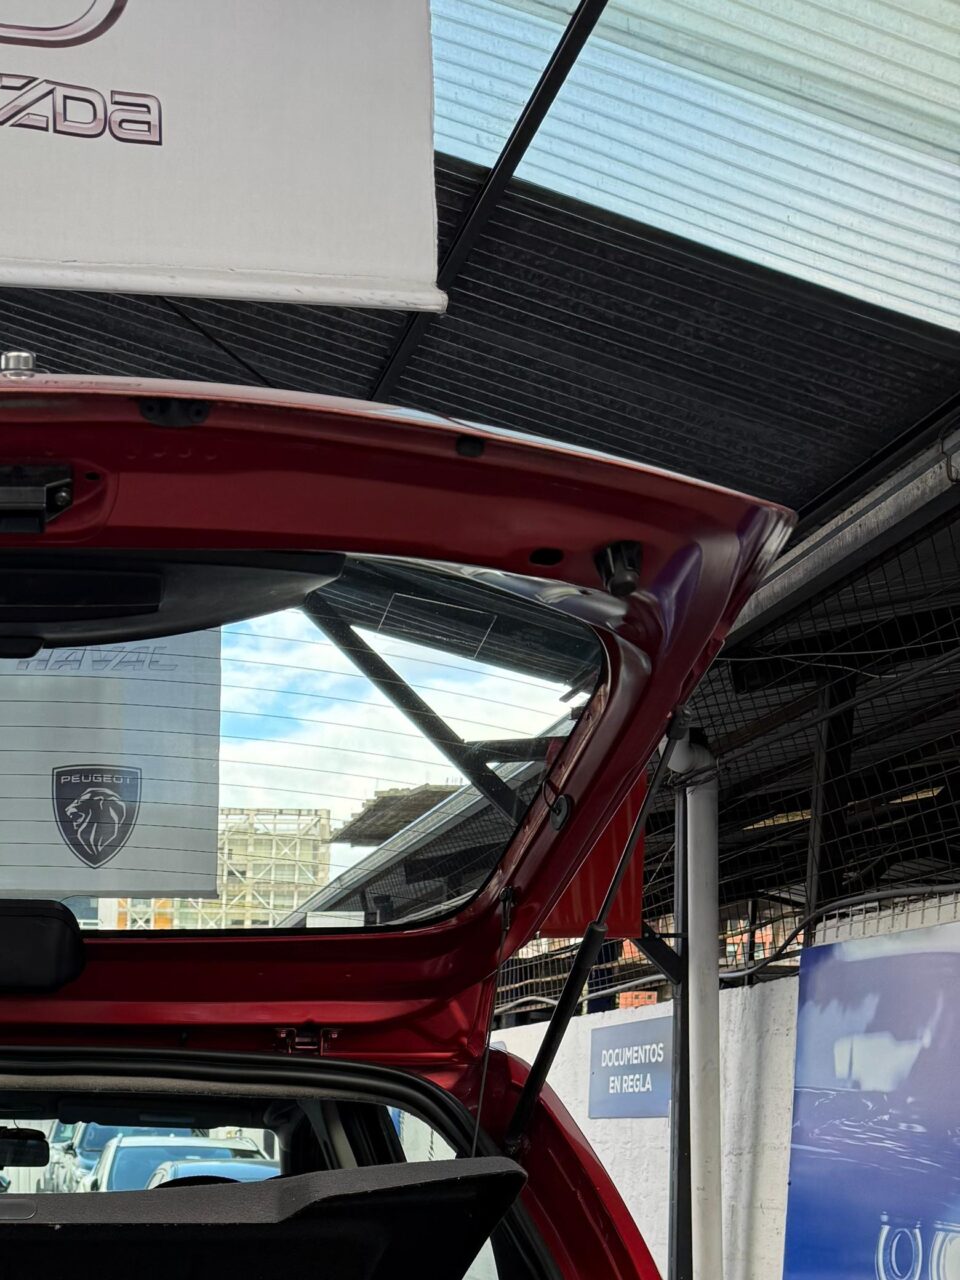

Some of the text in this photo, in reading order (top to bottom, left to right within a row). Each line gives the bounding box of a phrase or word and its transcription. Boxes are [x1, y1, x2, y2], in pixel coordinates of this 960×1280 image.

[61, 774, 136, 784] PEUGEOT
[601, 1042, 664, 1067] DOCUMENTOS
[609, 1073, 652, 1093] EN REGLA
